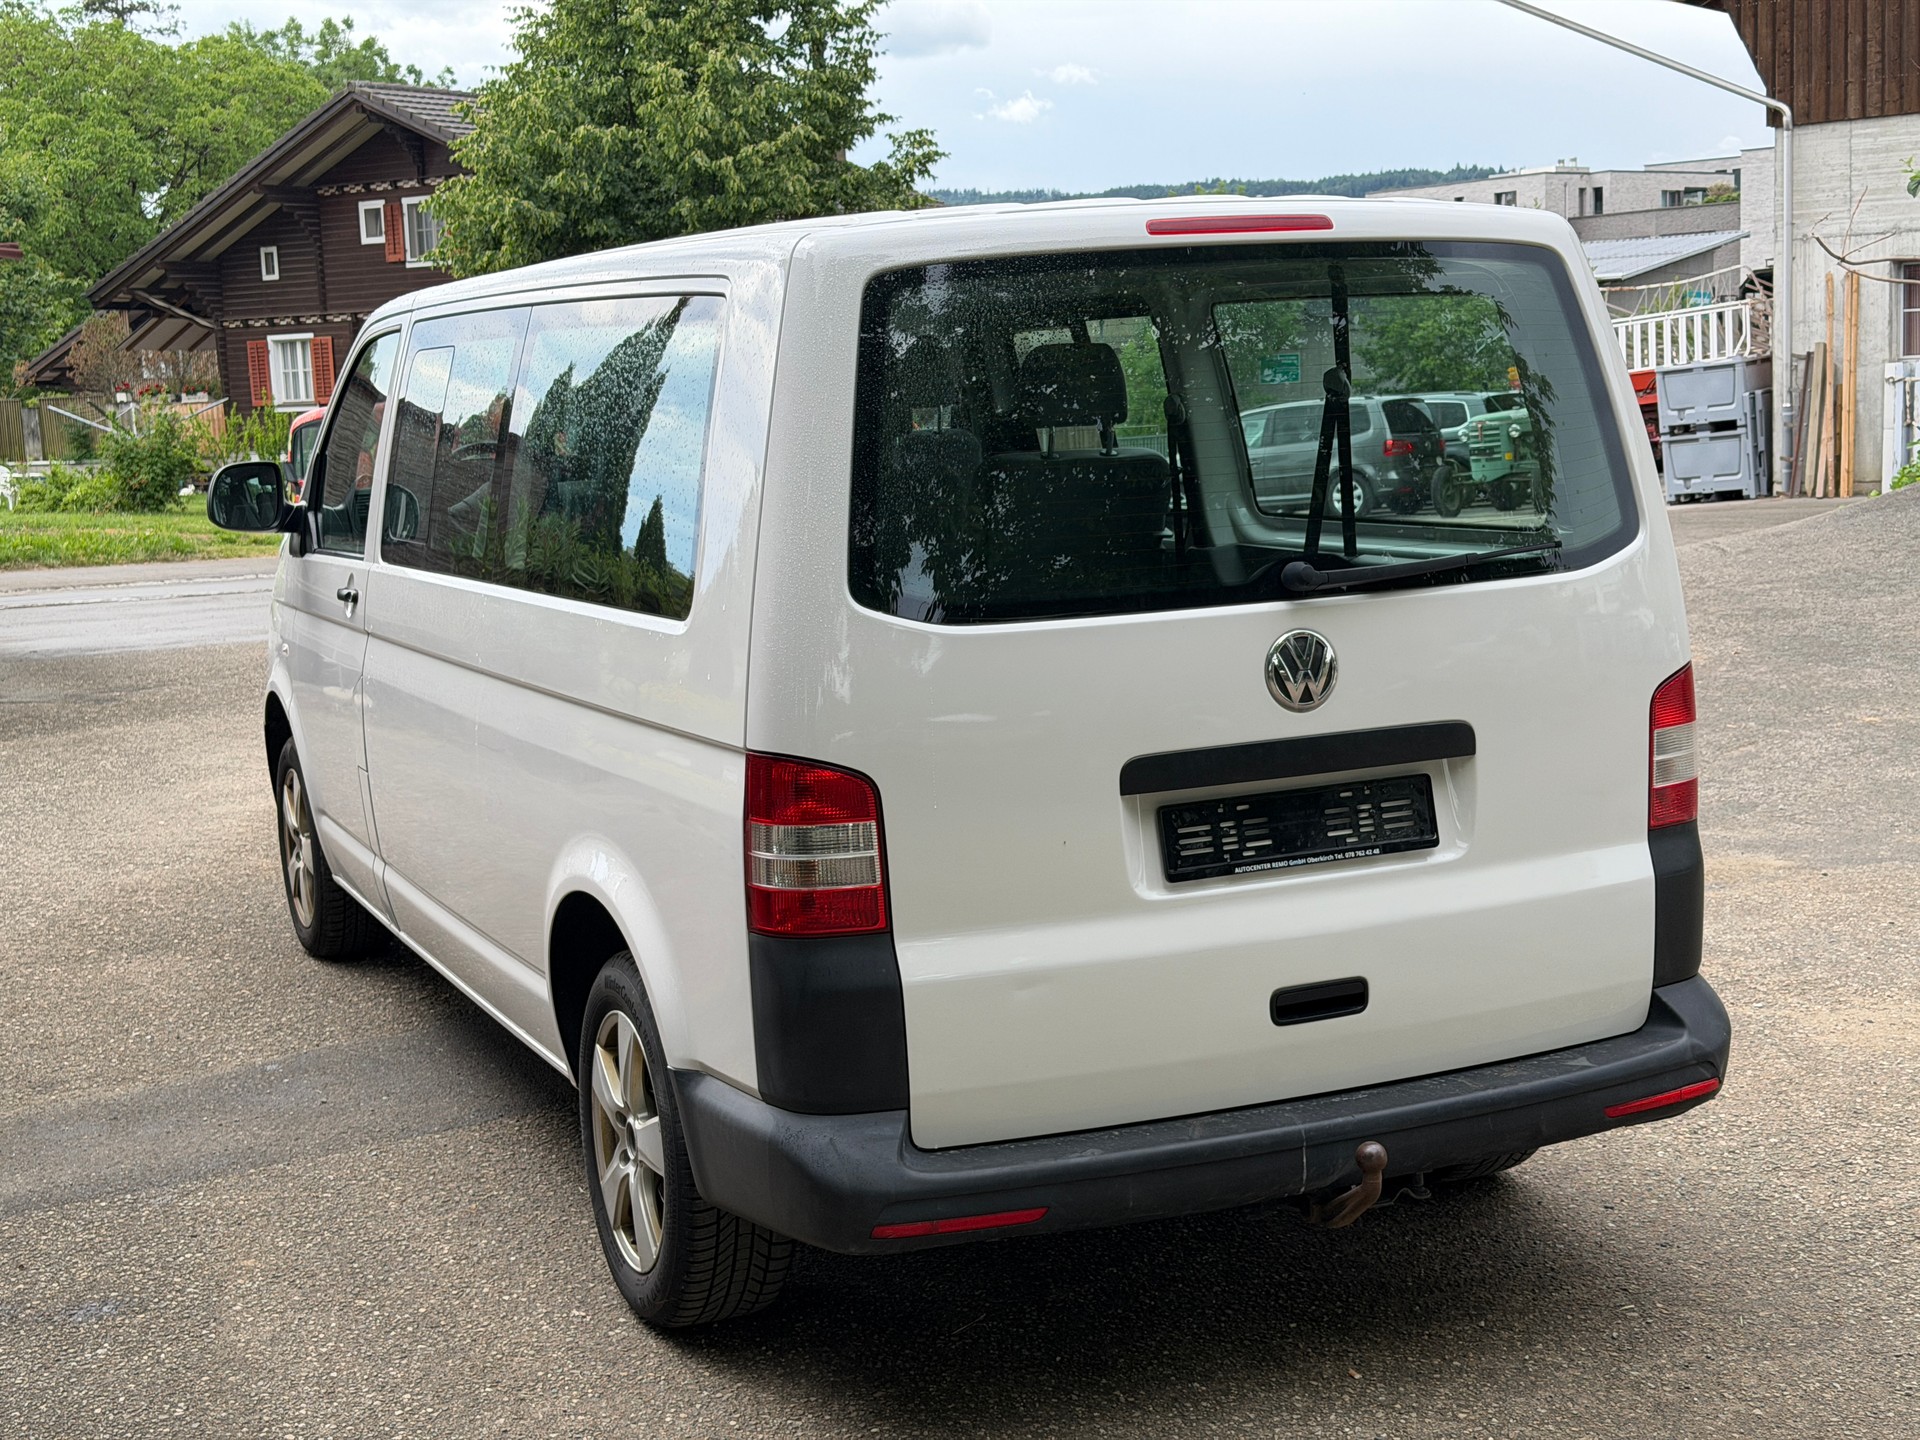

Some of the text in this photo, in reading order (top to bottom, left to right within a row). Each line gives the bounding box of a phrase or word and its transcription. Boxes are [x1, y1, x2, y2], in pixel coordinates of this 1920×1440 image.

[1268, 631, 1334, 708] VW
[1235, 863, 1271, 873] AUTOCENTER
[1272, 860, 1288, 868] REMO
[1289, 857, 1306, 865] GmbH
[1307, 854, 1334, 863] Oberkirch
